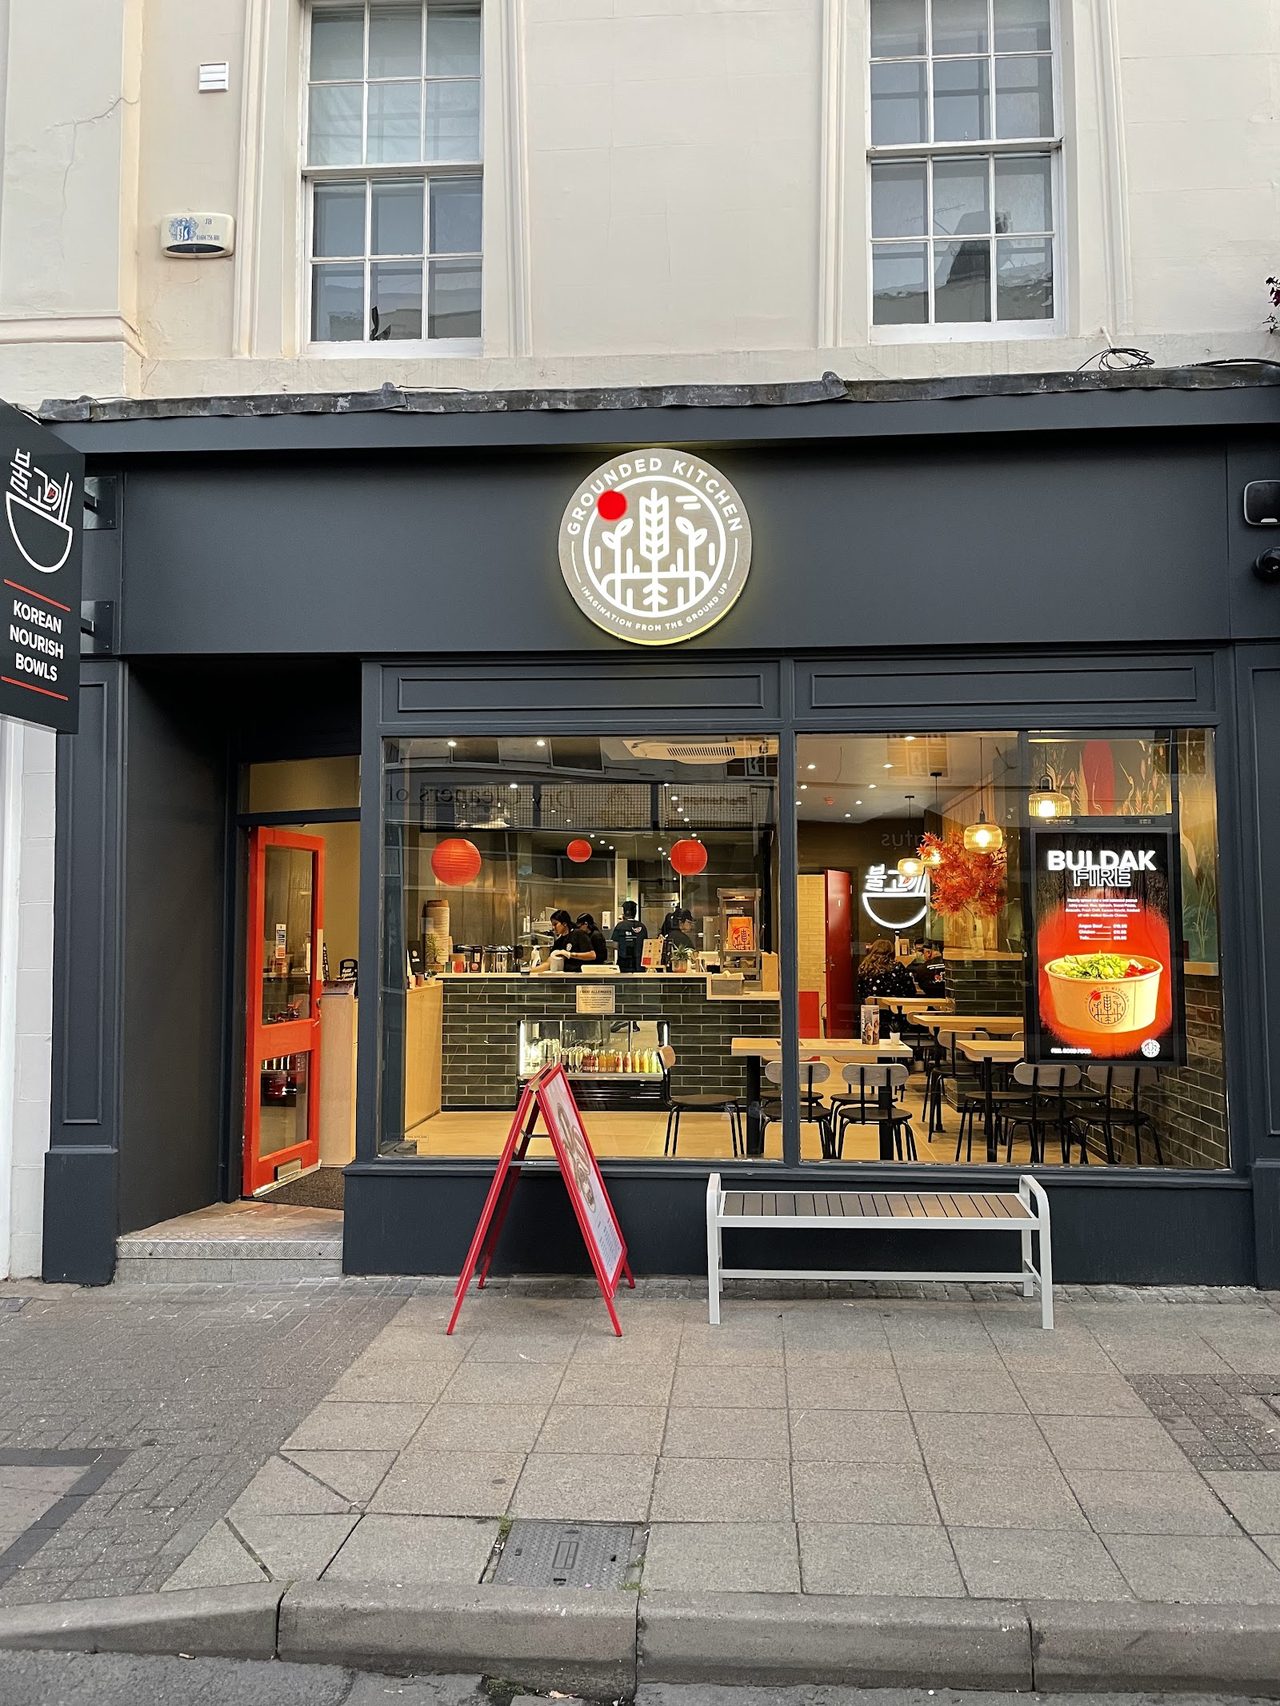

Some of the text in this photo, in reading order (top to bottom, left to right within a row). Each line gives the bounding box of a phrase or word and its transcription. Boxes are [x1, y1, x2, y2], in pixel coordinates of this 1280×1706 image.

[567, 457, 743, 535] GROUNDED KITCHEN
[13, 599, 62, 634] KOREAN
[581, 583, 728, 632] IMAGINATION FROM THE GROUND UP
[9, 624, 64, 660] NOURISH
[15, 652, 58, 682] BOWLS
[1047, 850, 1157, 871] BULDAK
[1073, 867, 1132, 887] FIRE
